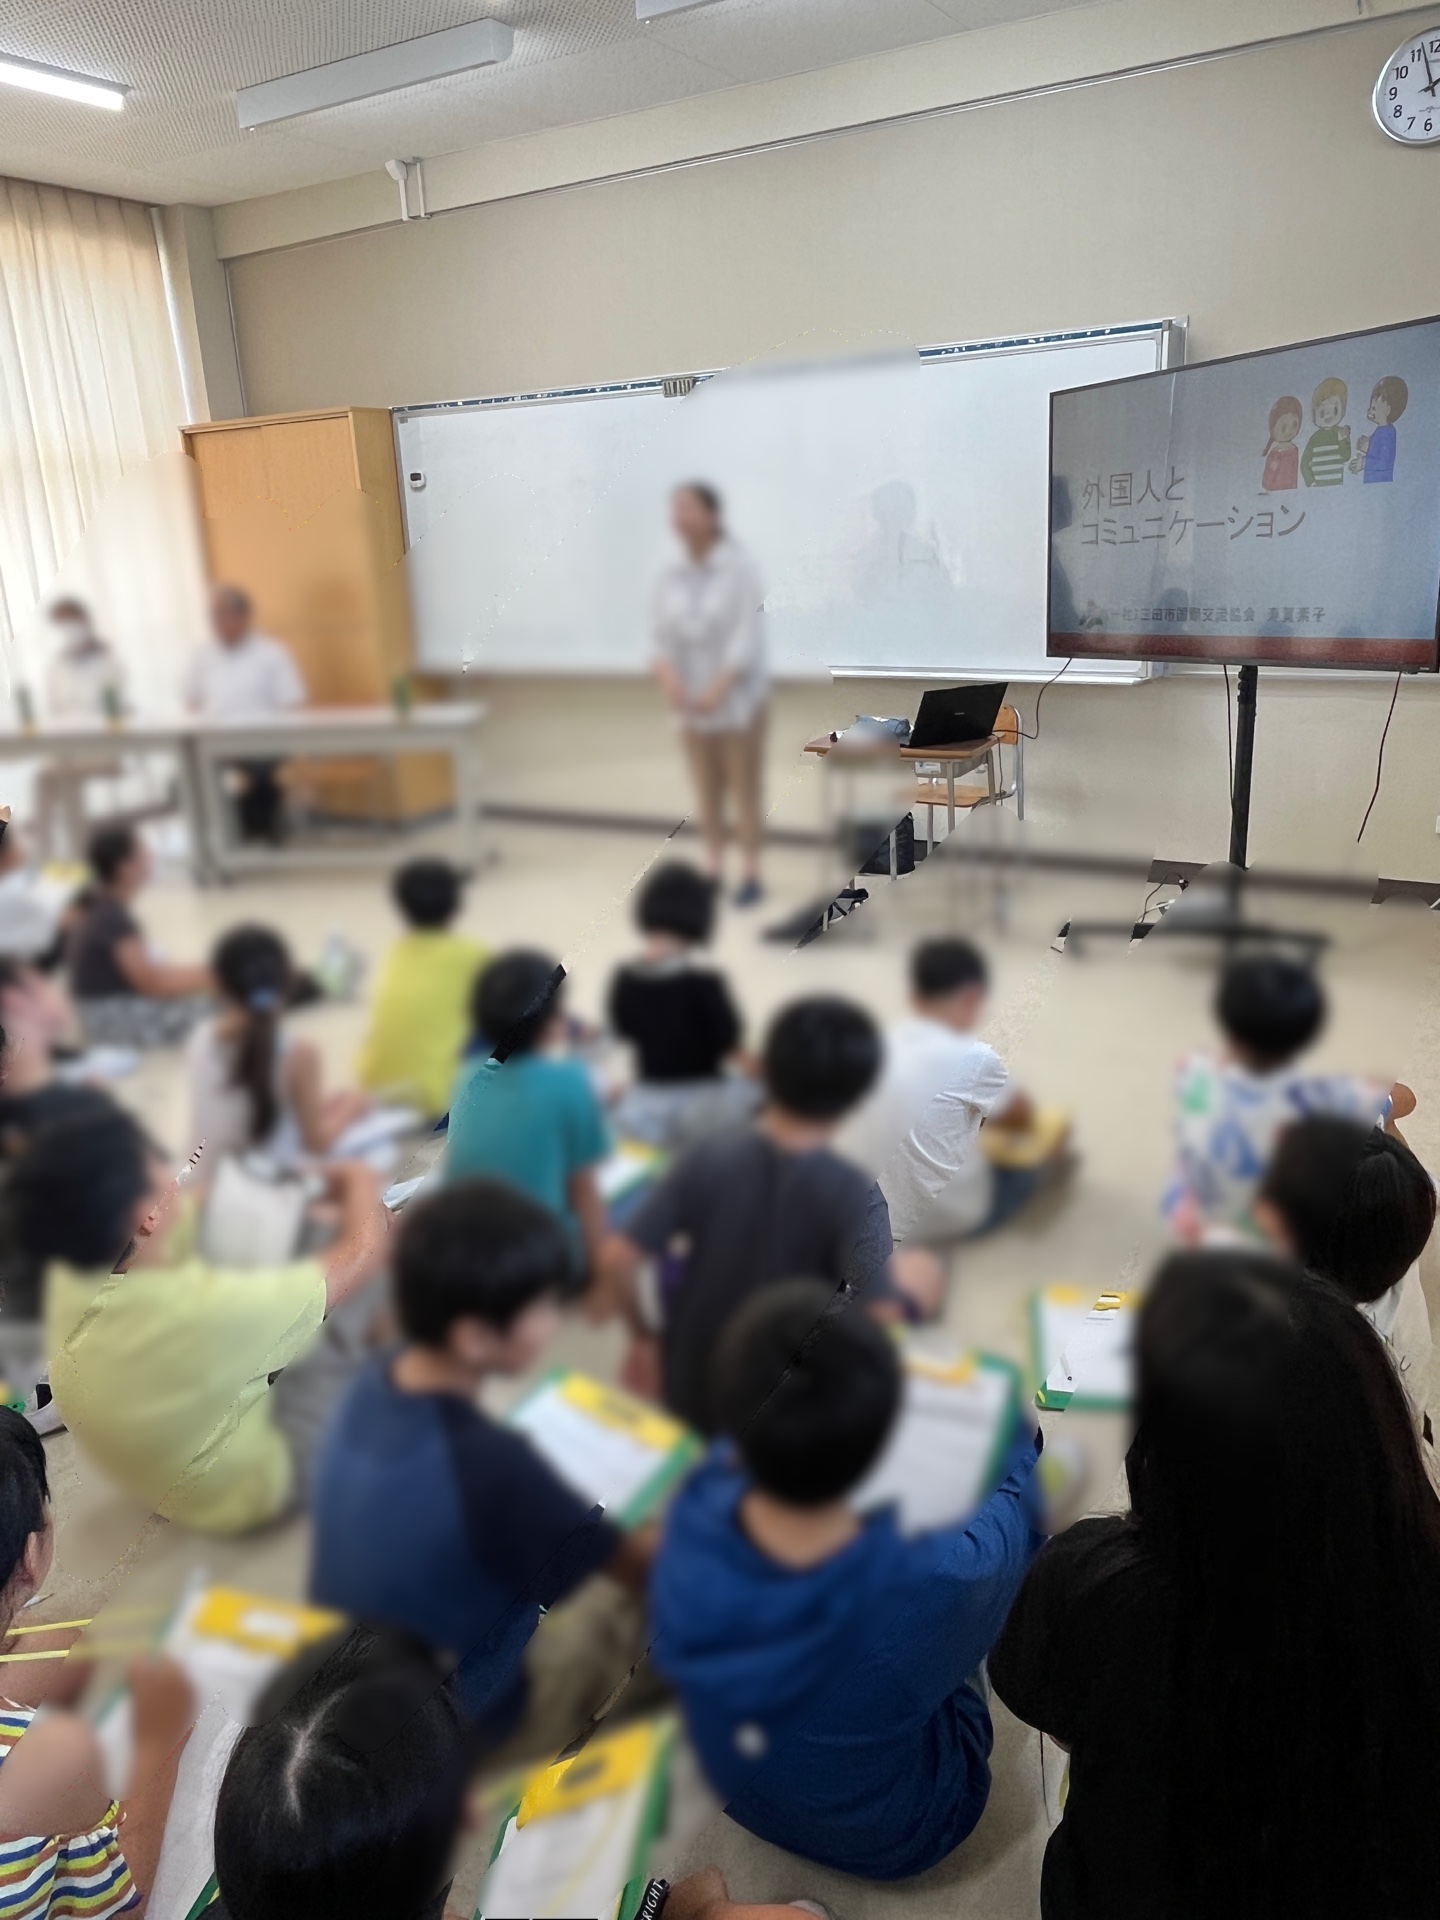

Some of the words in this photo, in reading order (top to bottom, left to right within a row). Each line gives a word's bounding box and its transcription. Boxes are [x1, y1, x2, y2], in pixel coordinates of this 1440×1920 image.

[1411, 48, 1421, 62] 11
[1395, 65, 1408, 80] 10
[1389, 86, 1397, 100] 9
[1393, 104, 1402, 118] 8
[1407, 116, 1416, 130] 7
[1424, 118, 1432, 131] 6
[1082, 466, 1185, 510] 外国人と
[1081, 505, 1306, 545] コミュニケーション
[640, 1881, 664, 1920] RIGHT
